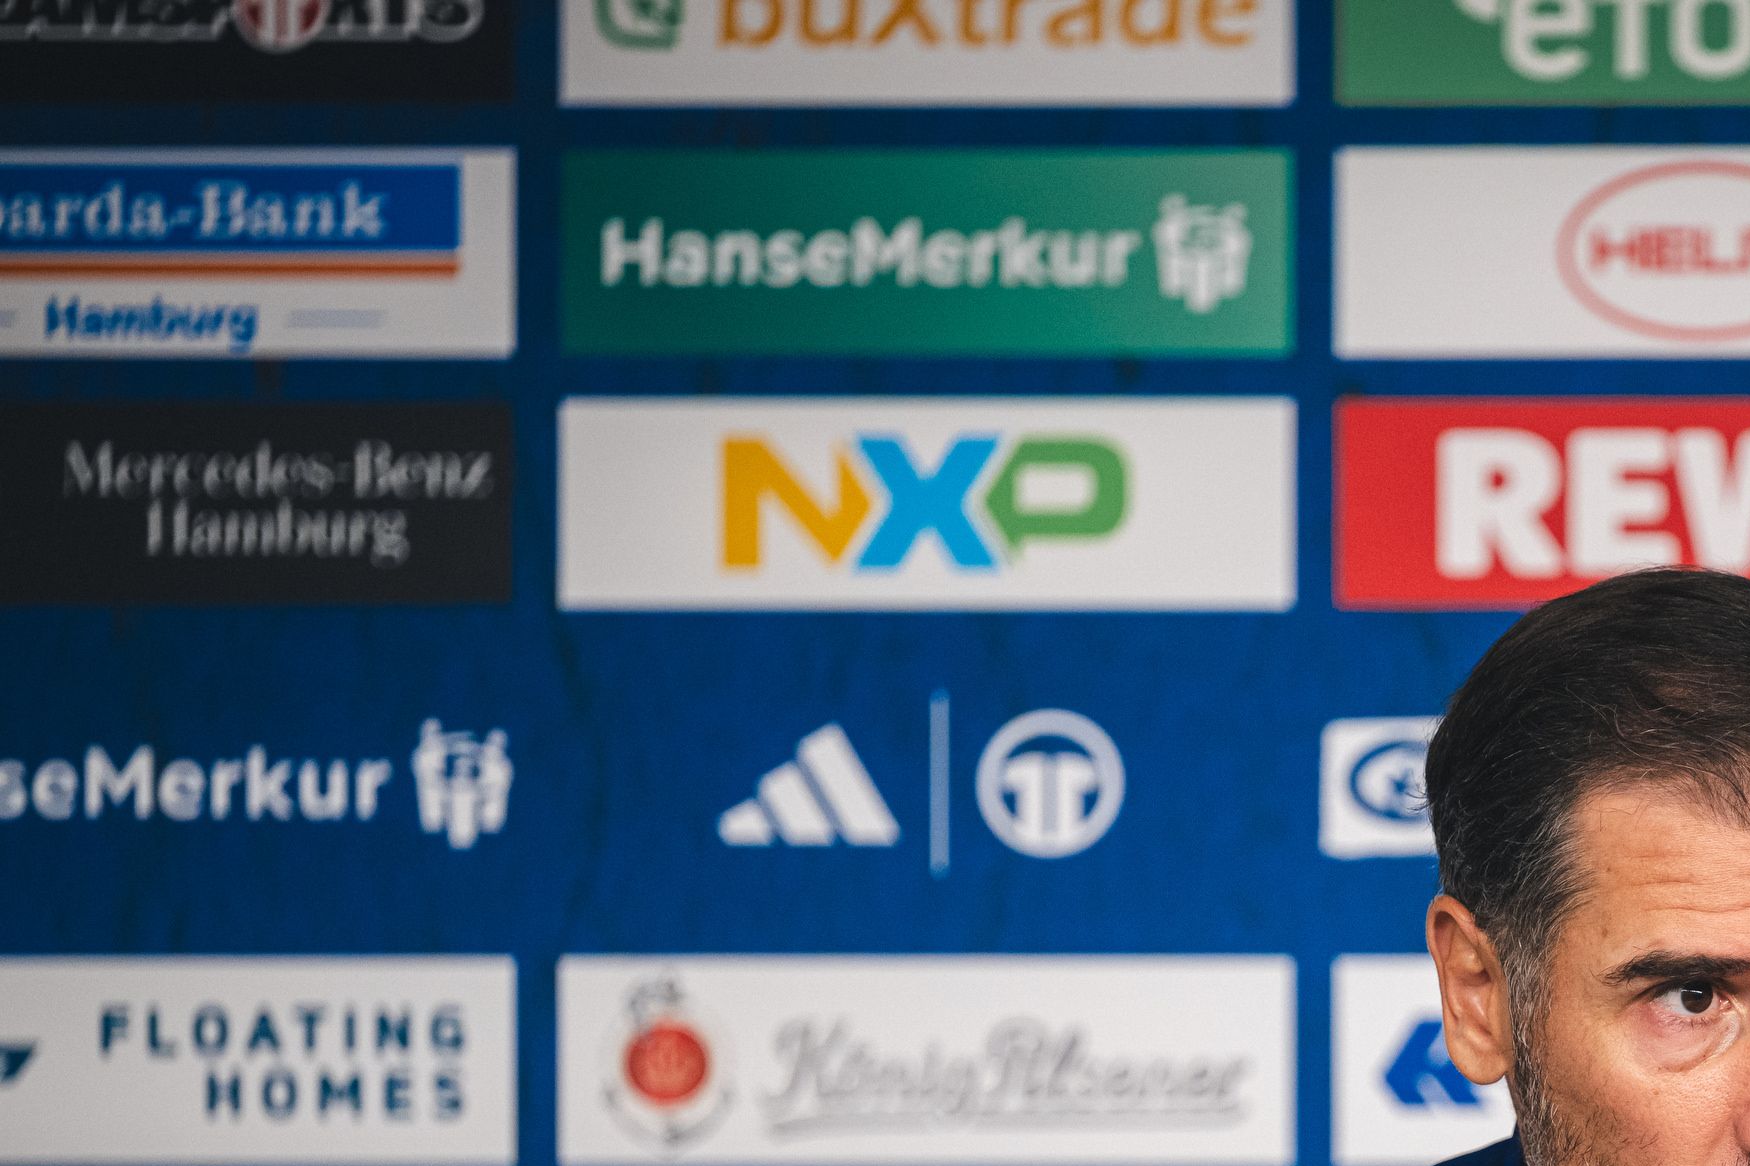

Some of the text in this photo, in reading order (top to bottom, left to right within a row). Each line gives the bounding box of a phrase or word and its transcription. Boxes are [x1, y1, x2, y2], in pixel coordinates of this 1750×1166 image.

[0, 180, 387, 242] arda-Bank
[600, 217, 1143, 289] HanseMerkur
[43, 292, 260, 354] Hamburg
[62, 438, 495, 502] Mercedes-Benz
[145, 501, 410, 567] Hamburg
[718, 430, 1134, 575] NXP
[96, 1003, 467, 1058] FLOATING
[202, 1069, 466, 1124] HOMES
